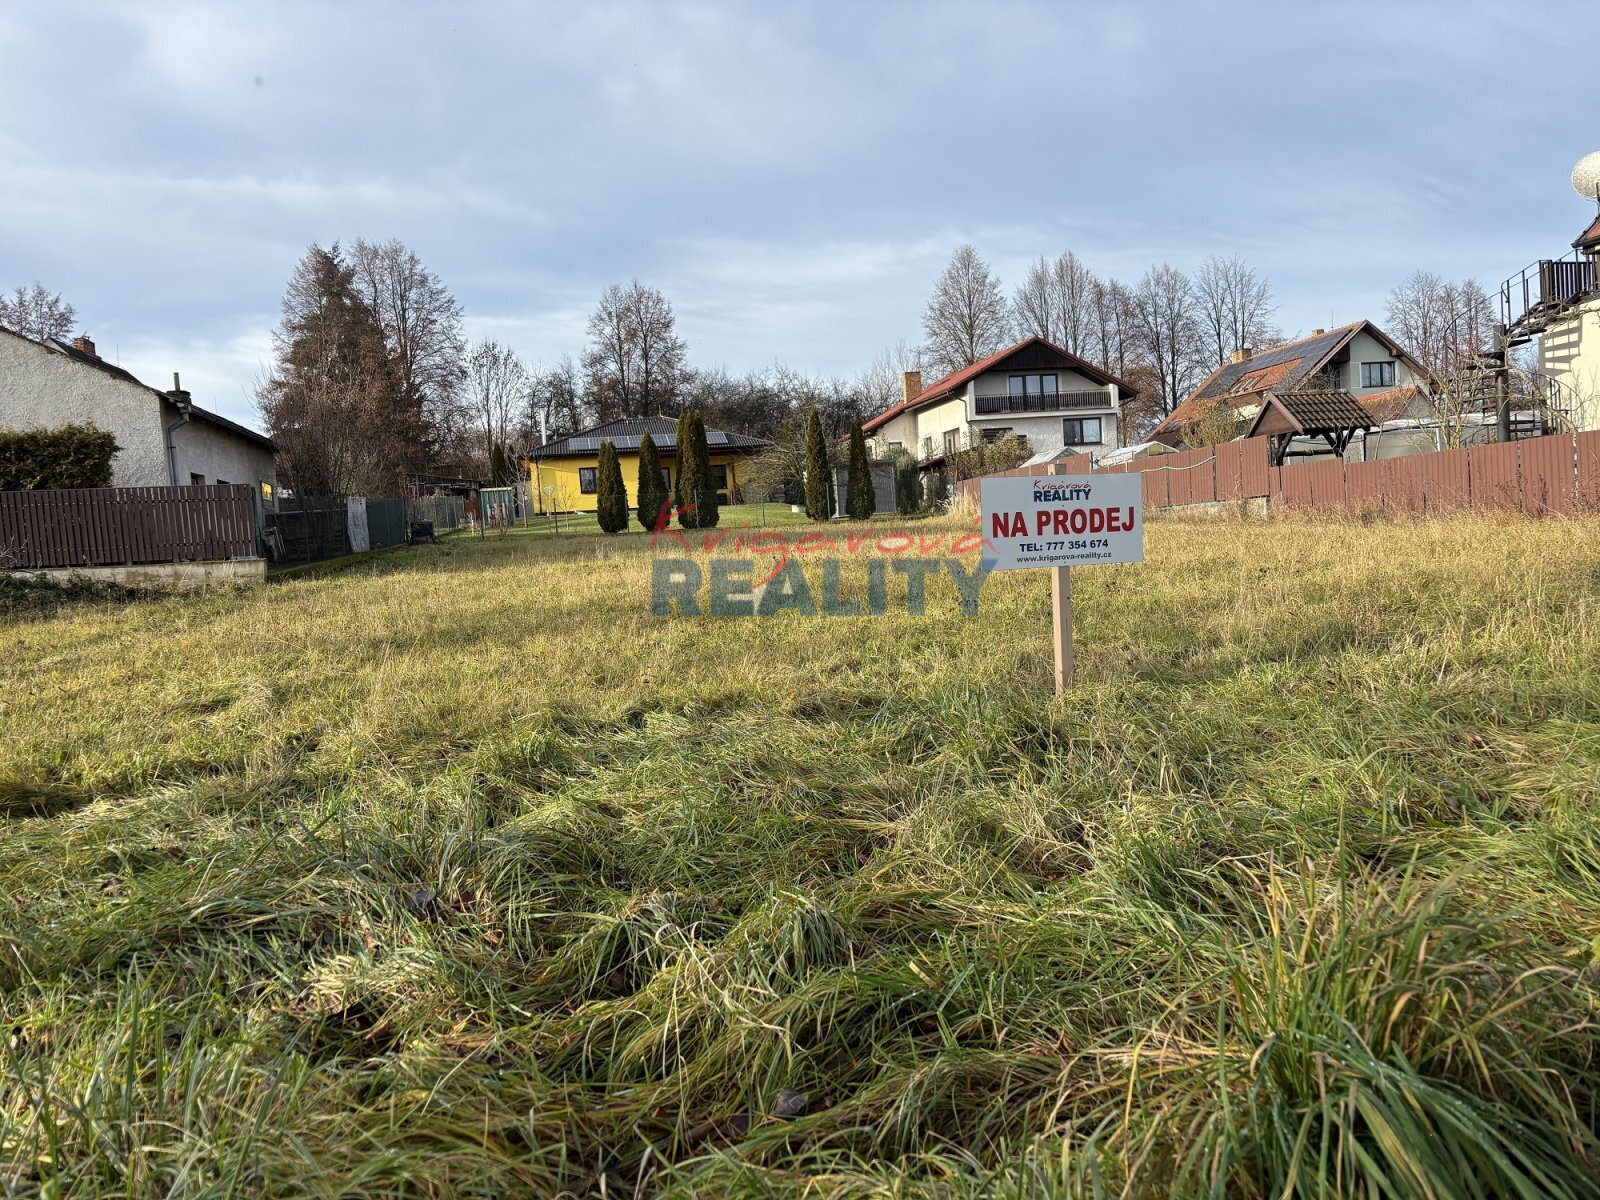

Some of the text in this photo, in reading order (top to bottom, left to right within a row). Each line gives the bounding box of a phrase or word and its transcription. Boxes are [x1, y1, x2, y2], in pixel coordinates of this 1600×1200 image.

[1033, 489, 1091, 502] REALITY
[992, 506, 1135, 538] NA PRODEJ
[1019, 538, 1108, 552] TEL: 777 354 674
[1016, 552, 1112, 563] www.krigarova-reality.cz
